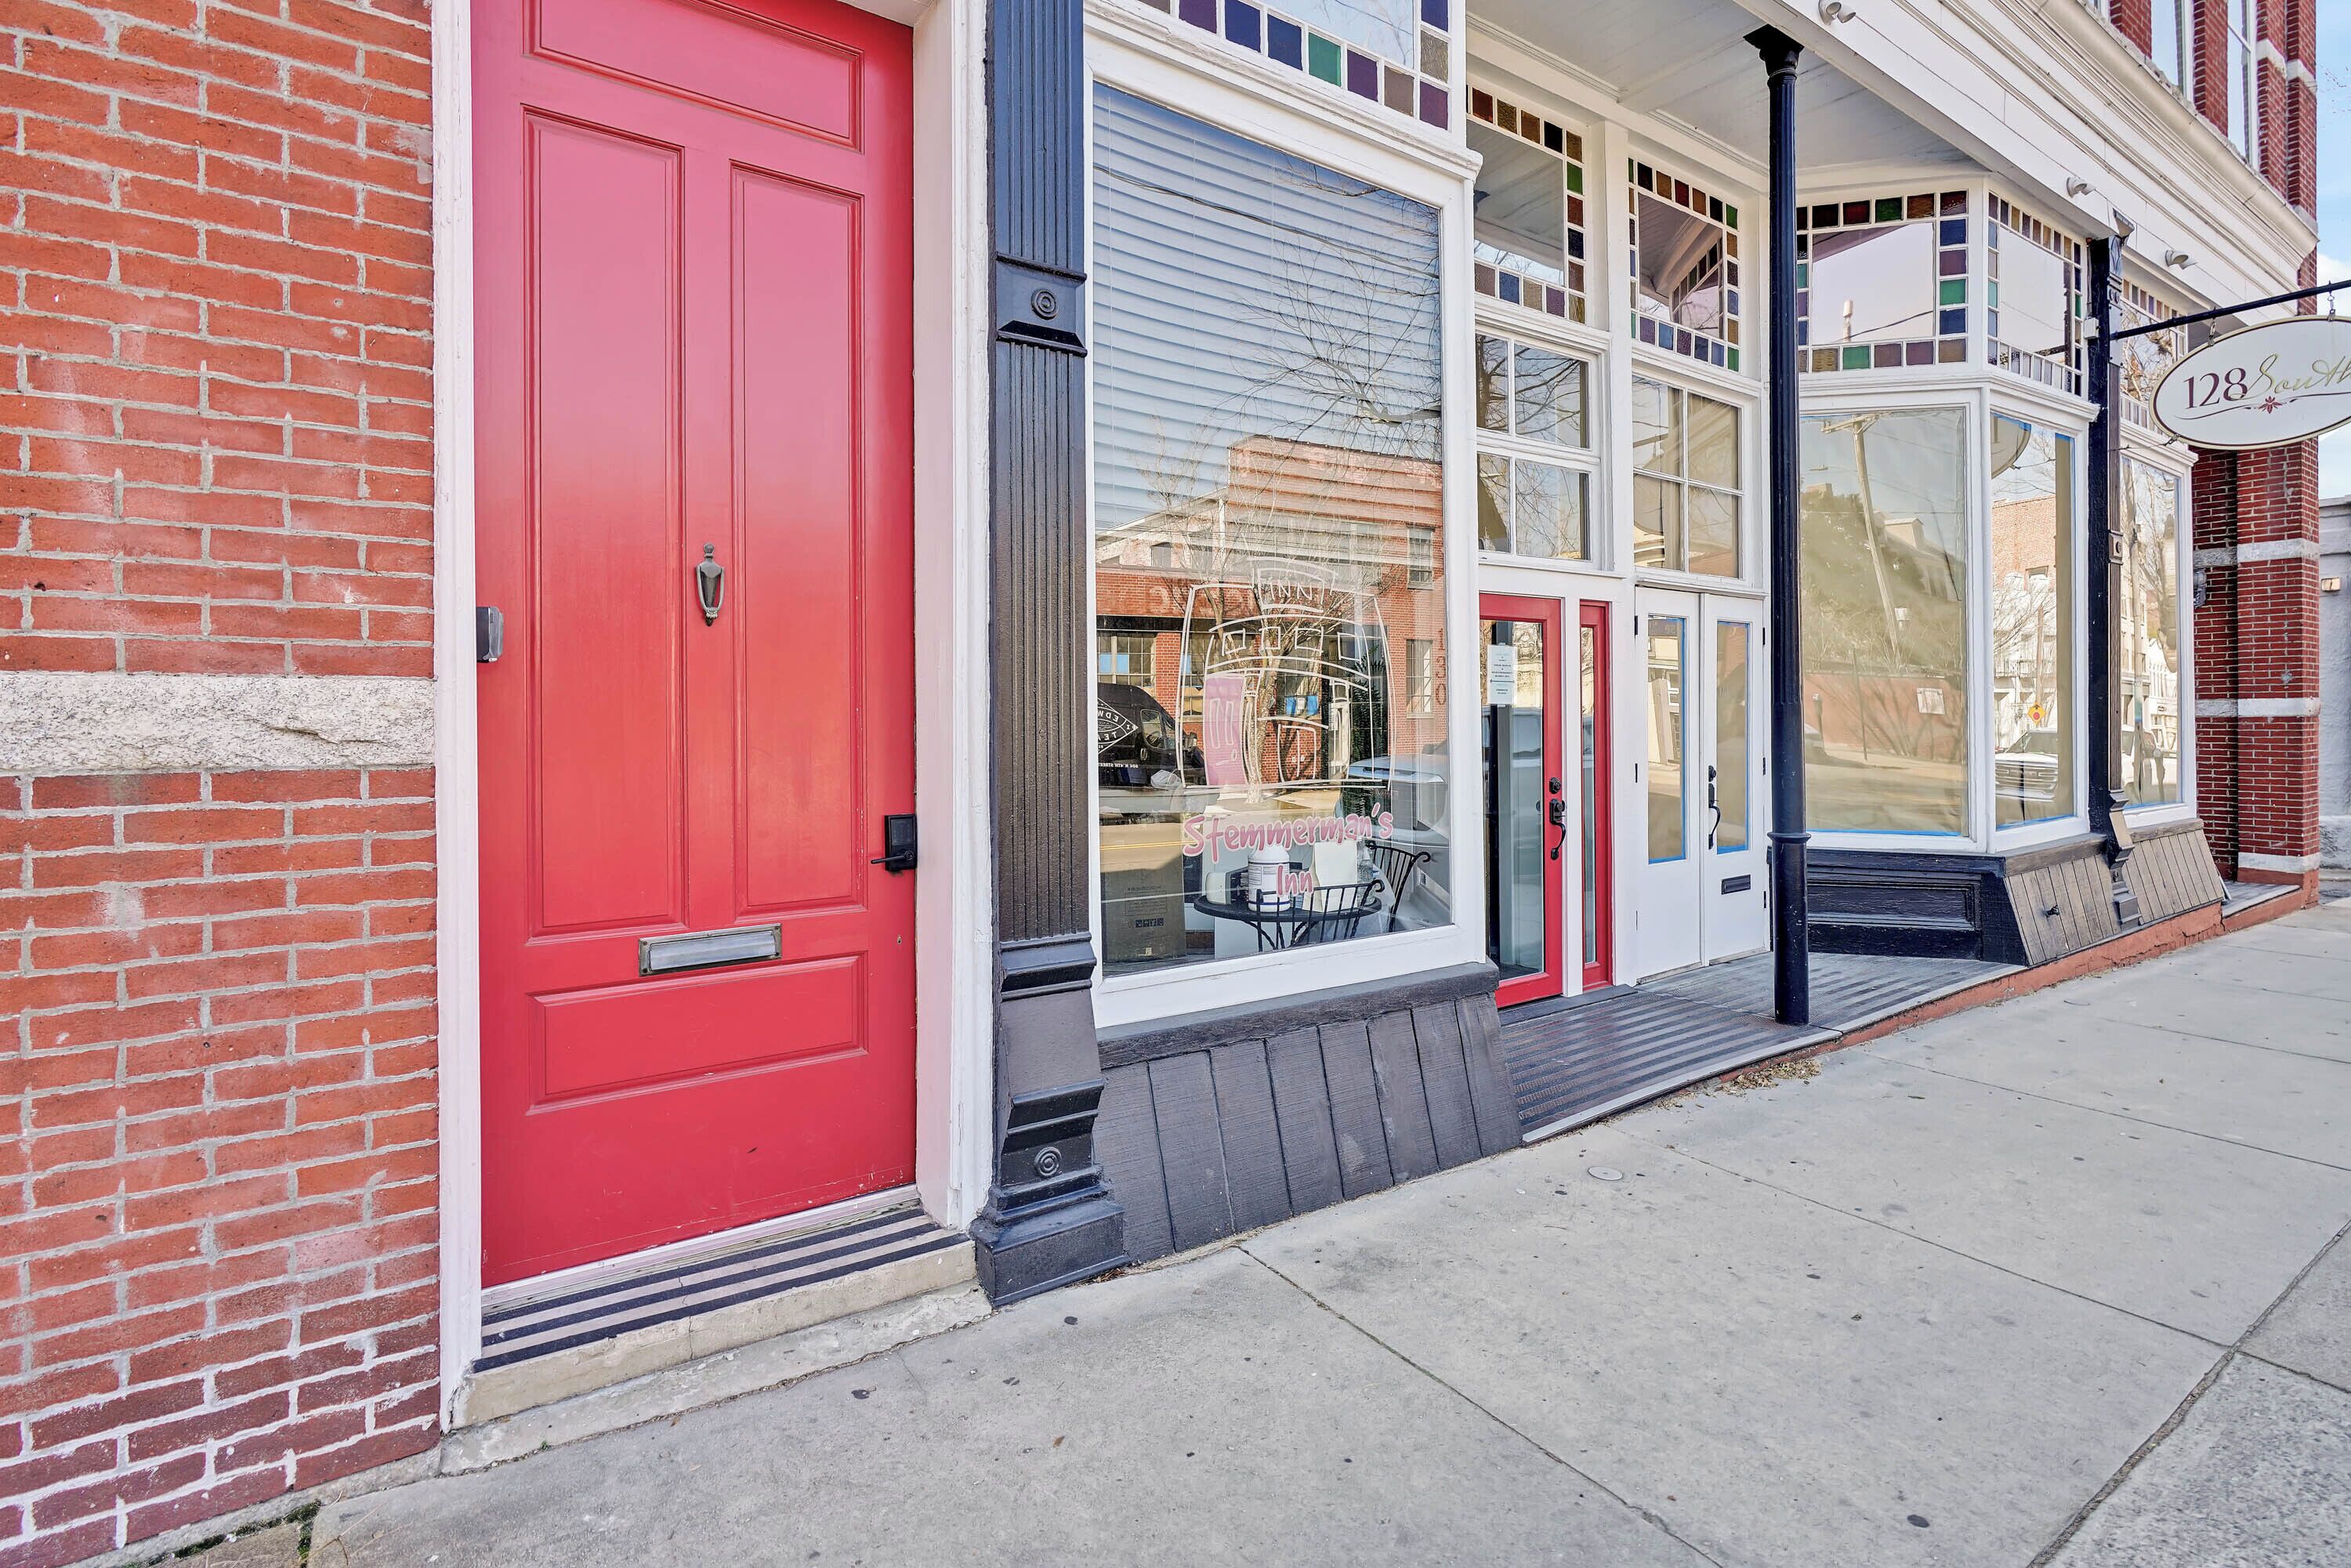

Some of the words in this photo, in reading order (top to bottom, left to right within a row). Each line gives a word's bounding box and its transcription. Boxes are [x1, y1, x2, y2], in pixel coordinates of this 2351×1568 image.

[2183, 367, 2248, 410] 128
[1183, 802, 1393, 864] Stemmerman's
[1275, 864, 1314, 896] Inn
